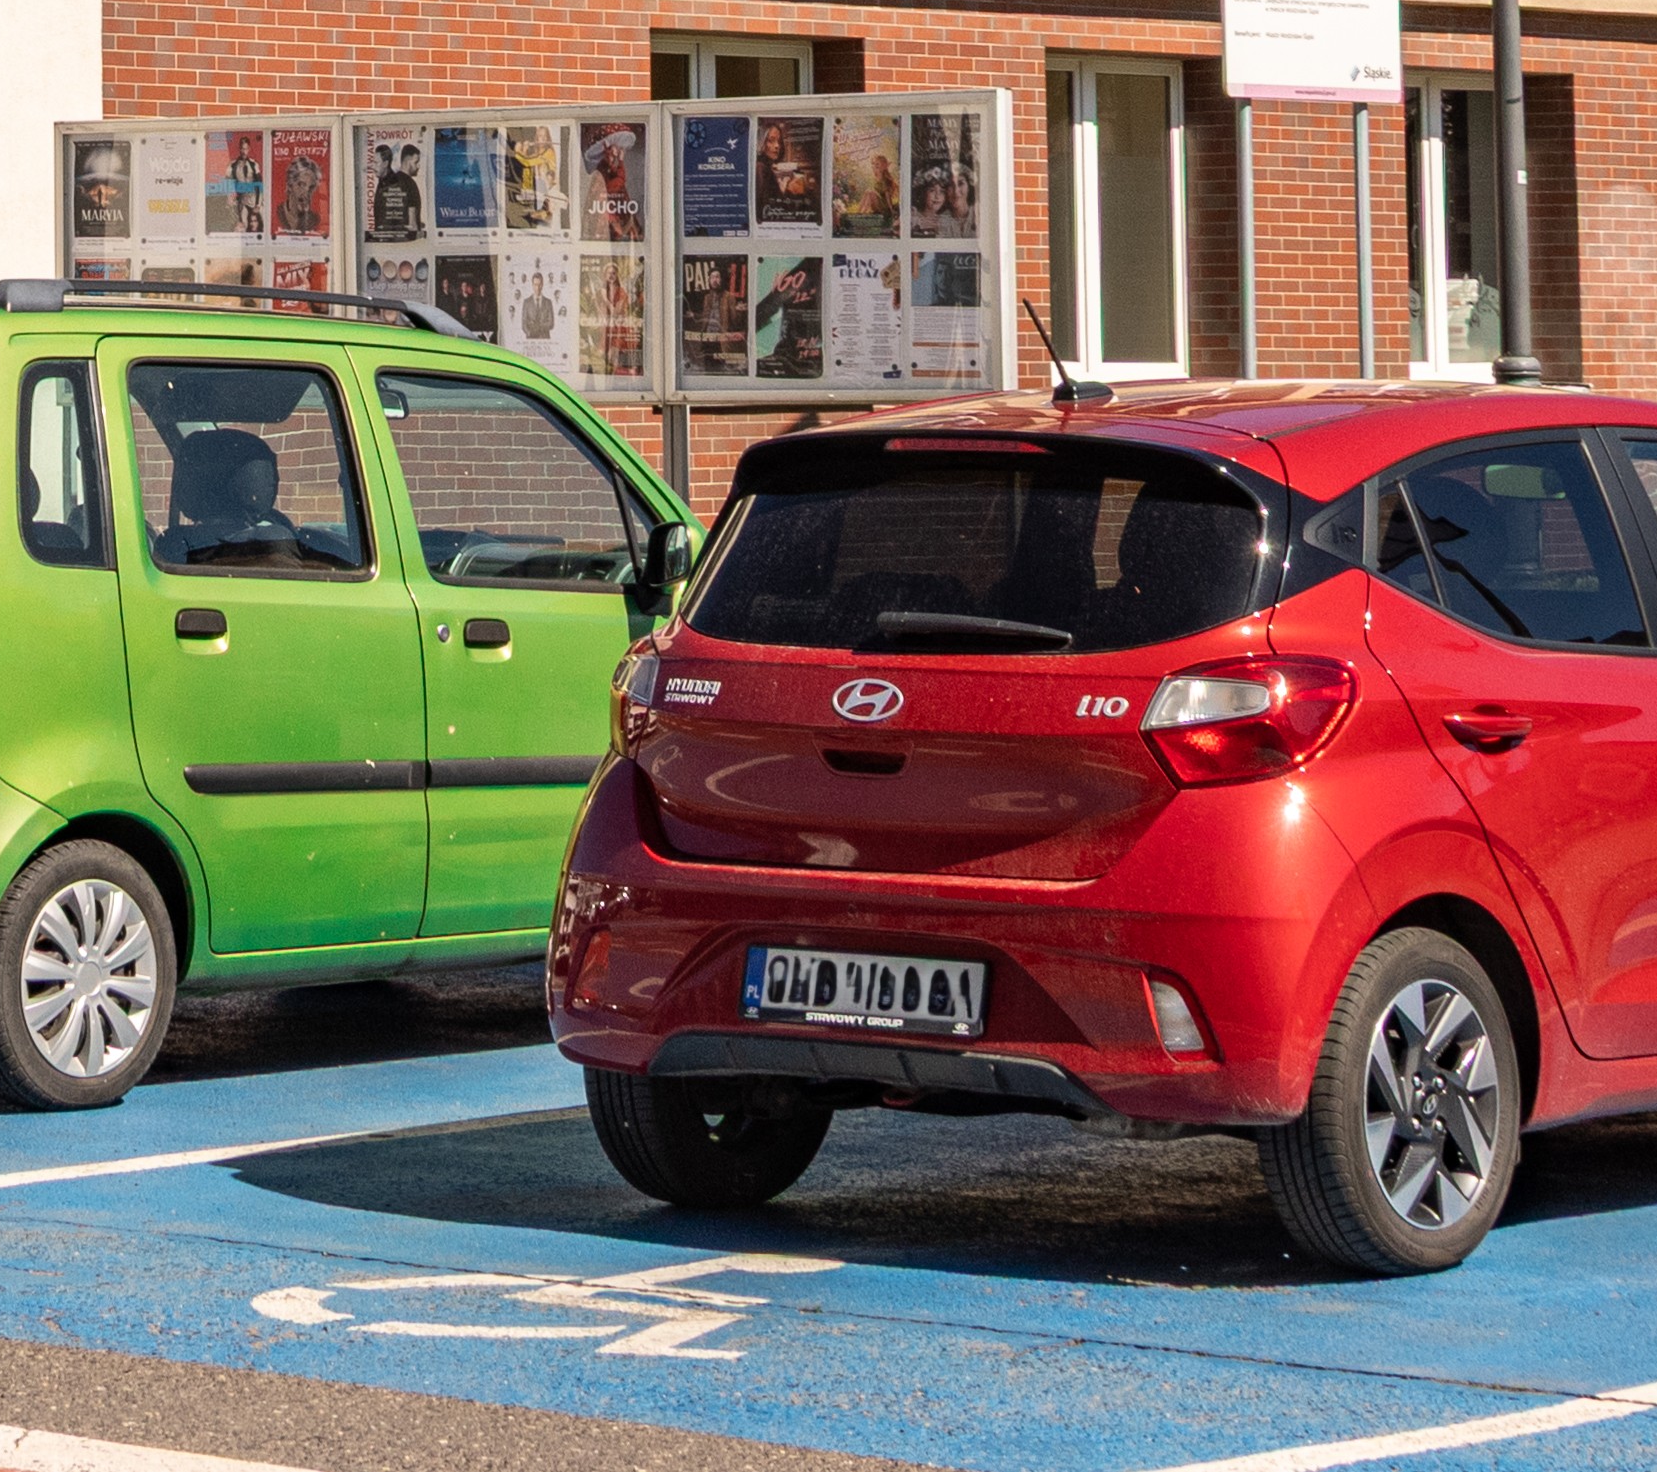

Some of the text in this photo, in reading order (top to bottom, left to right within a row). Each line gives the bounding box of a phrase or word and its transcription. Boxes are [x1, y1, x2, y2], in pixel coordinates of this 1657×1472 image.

[376, 128, 413, 140] POWRÓT
[588, 199, 639, 215] JUCHO
[665, 677, 722, 696] HYUNDAI
[663, 692, 716, 705] STAWOWY
[1075, 694, 1130, 718] i10
[745, 984, 760, 999] PL
[805, 1011, 904, 1028] STAWOWY GROUP
